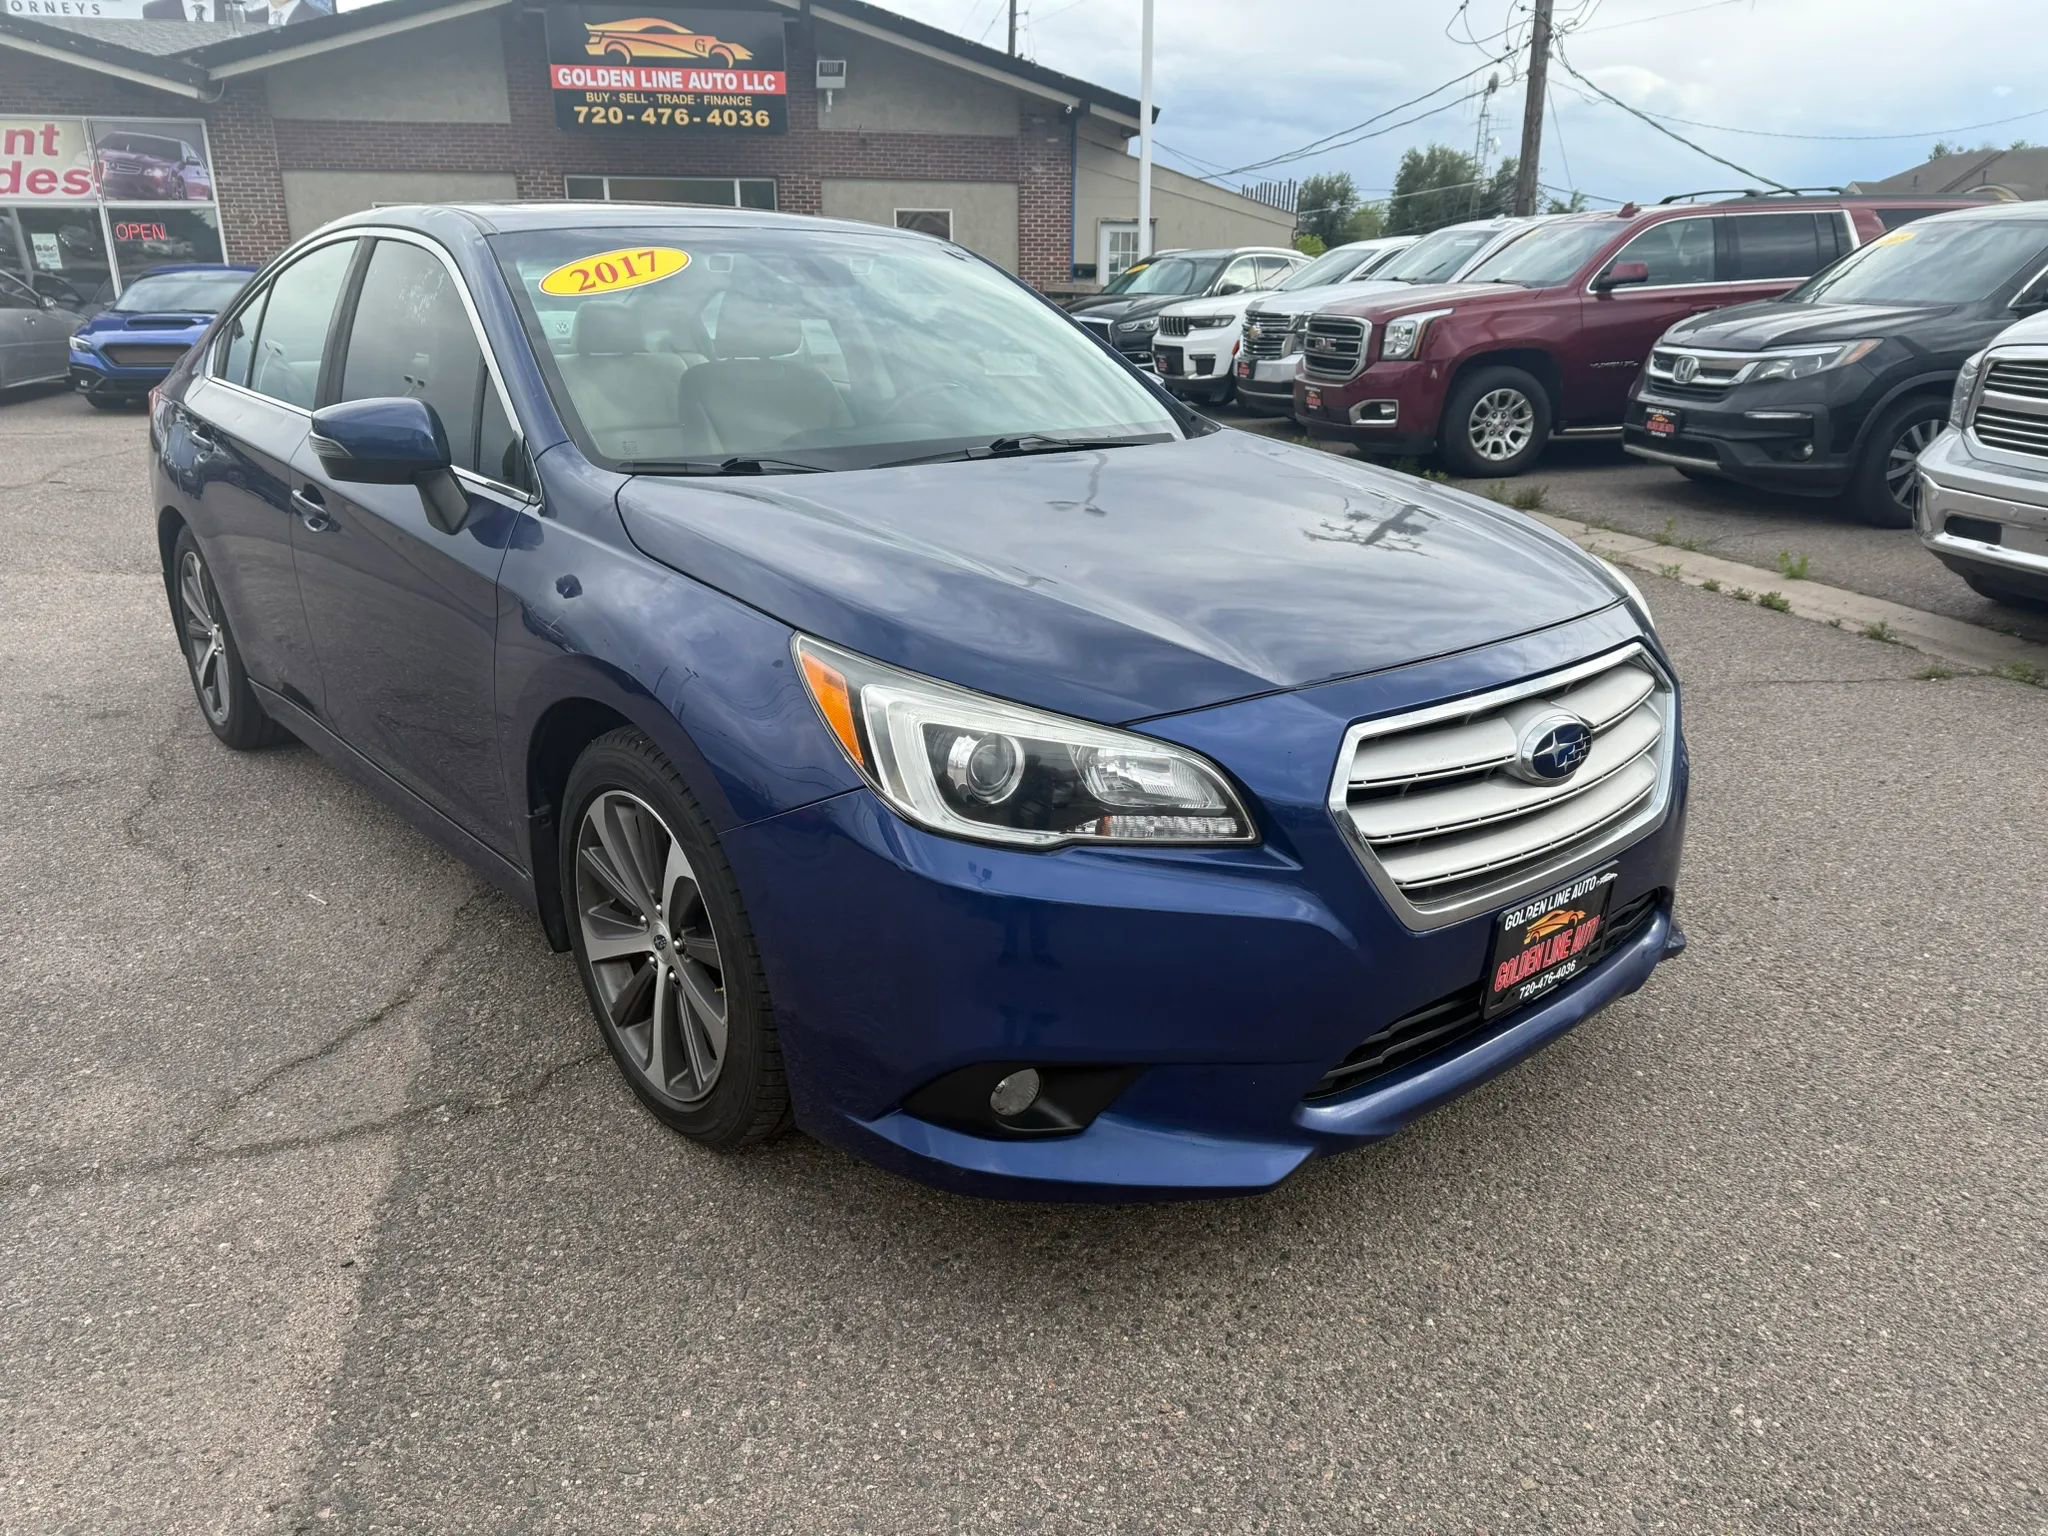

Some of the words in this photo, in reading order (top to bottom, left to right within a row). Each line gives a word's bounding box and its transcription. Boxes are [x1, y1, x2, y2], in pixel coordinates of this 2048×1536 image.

[11, 0, 101, 15] ORNEYS
[558, 68, 635, 87] GOLDEN
[641, 70, 683, 89] LINE
[688, 71, 737, 90] AUTO
[743, 73, 775, 91] LLC
[586, 92, 609, 103] BUY
[619, 93, 648, 104] SELL
[657, 94, 695, 105] TRADE
[704, 95, 752, 106] FINANCE
[4, 123, 60, 156] nt
[115, 223, 166, 241] OPEN
[569, 251, 656, 292] 2017
[1505, 898, 1549, 931] GOLDEN
[1548, 889, 1571, 909] LINE
[1571, 876, 1596, 900] AUTO
[1494, 941, 1545, 992] GOLDEN
[1543, 929, 1573, 968] LINE
[1519, 960, 1577, 999] 720-476-4036
